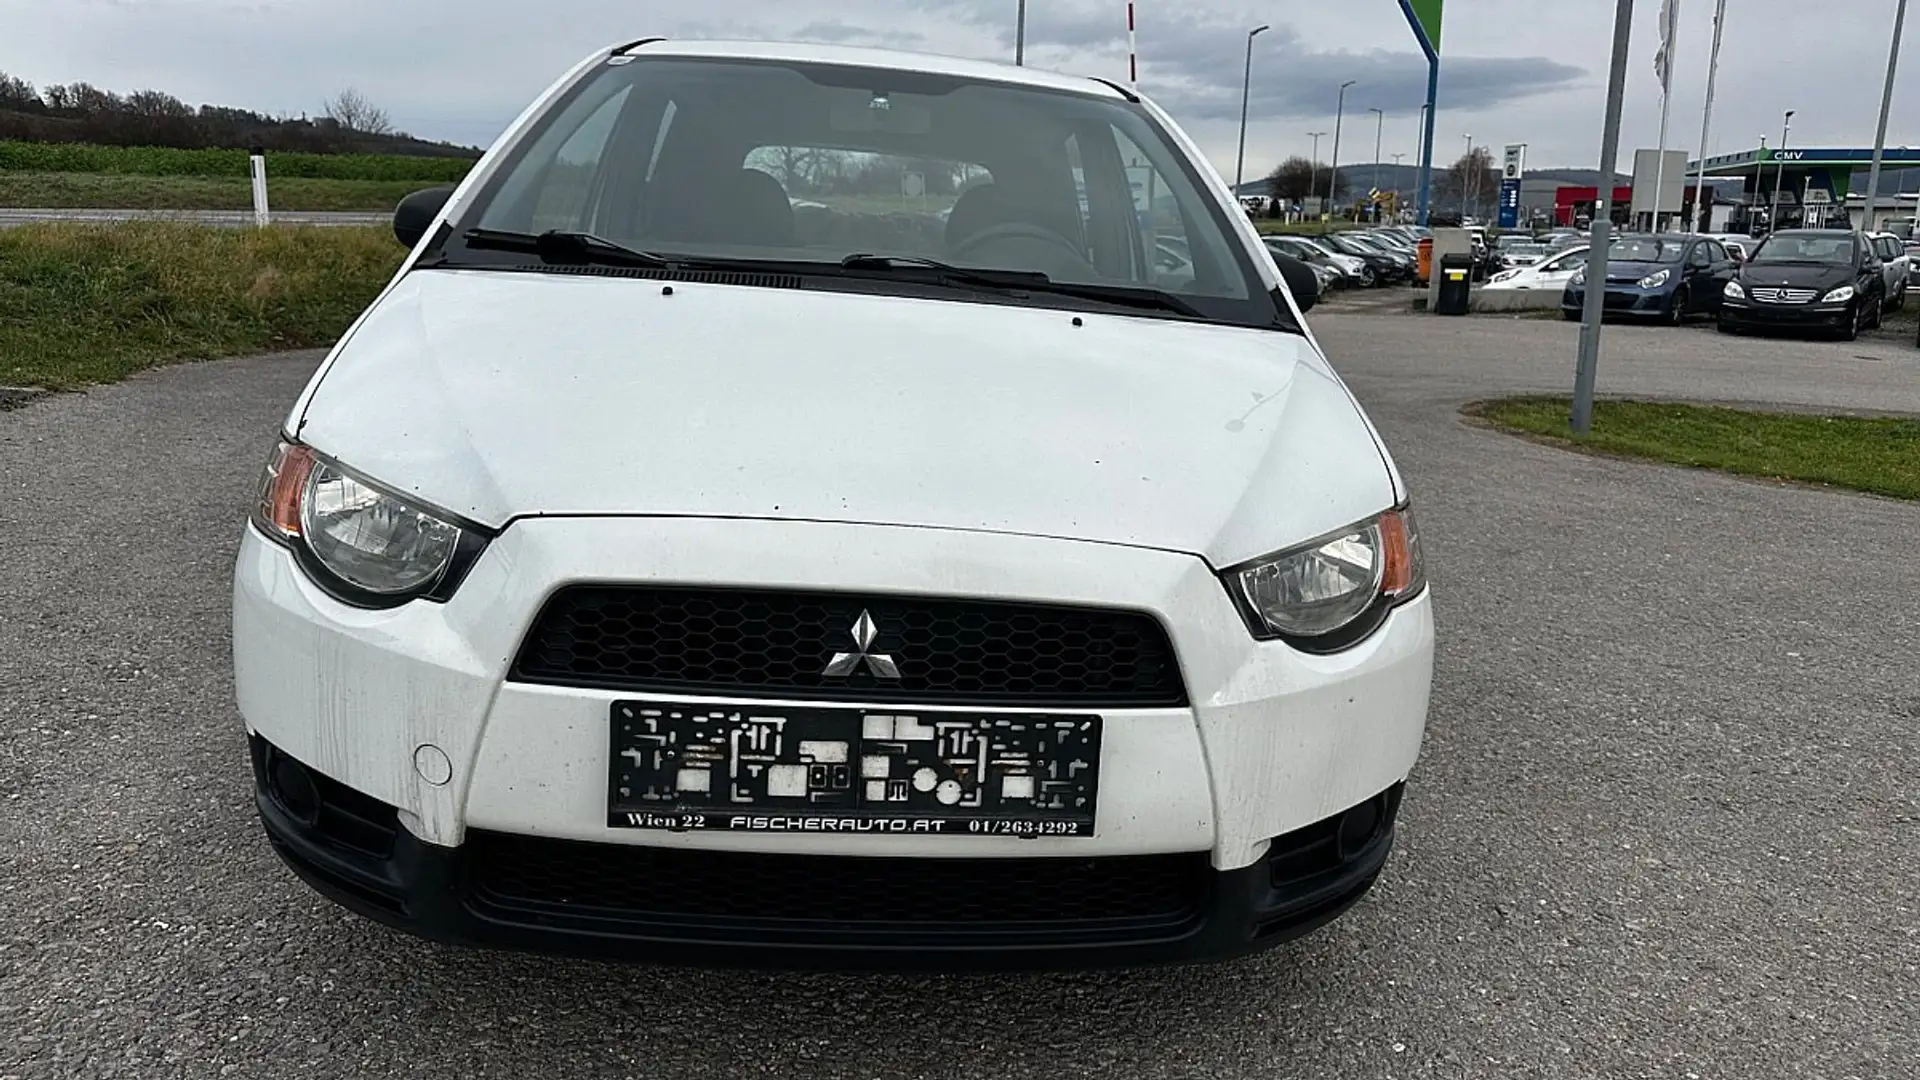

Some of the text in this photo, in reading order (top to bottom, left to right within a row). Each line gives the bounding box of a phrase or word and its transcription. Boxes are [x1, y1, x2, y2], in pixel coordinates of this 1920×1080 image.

[627, 812, 706, 828] Wien 22
[730, 816, 946, 832] FISCHERAUTO.AT
[968, 819, 1078, 834] 01/2634292
